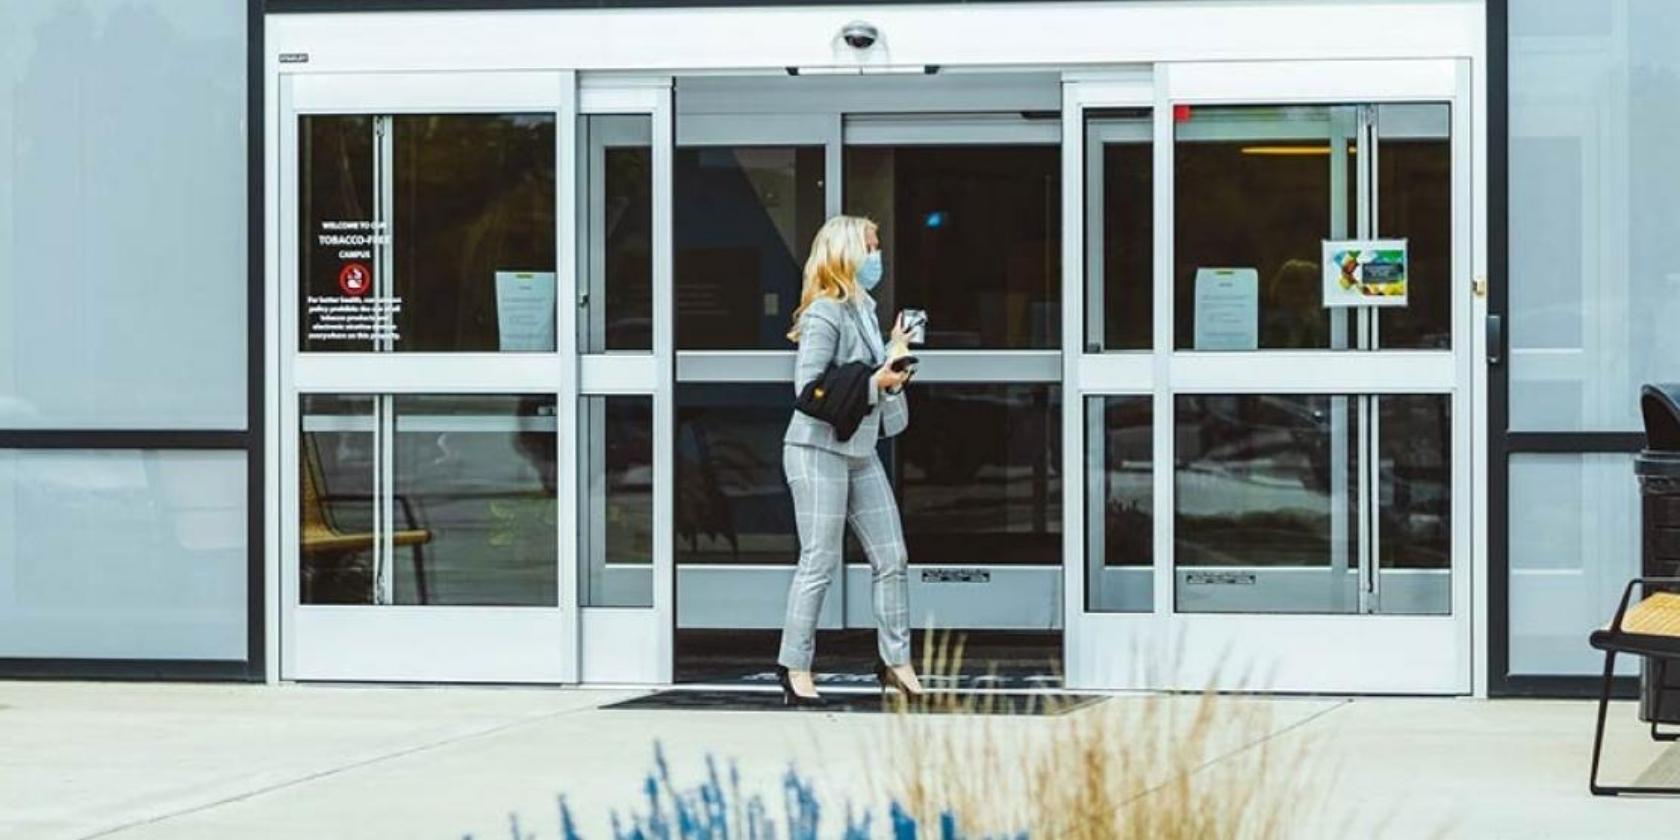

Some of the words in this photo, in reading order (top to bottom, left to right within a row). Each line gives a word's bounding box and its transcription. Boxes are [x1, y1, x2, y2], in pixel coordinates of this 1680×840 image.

[322, 221, 358, 229] WELCOME
[360, 221, 370, 229] TO
[318, 235, 391, 245] TOBACCO-FREE
[338, 250, 371, 258] CAMPUS
